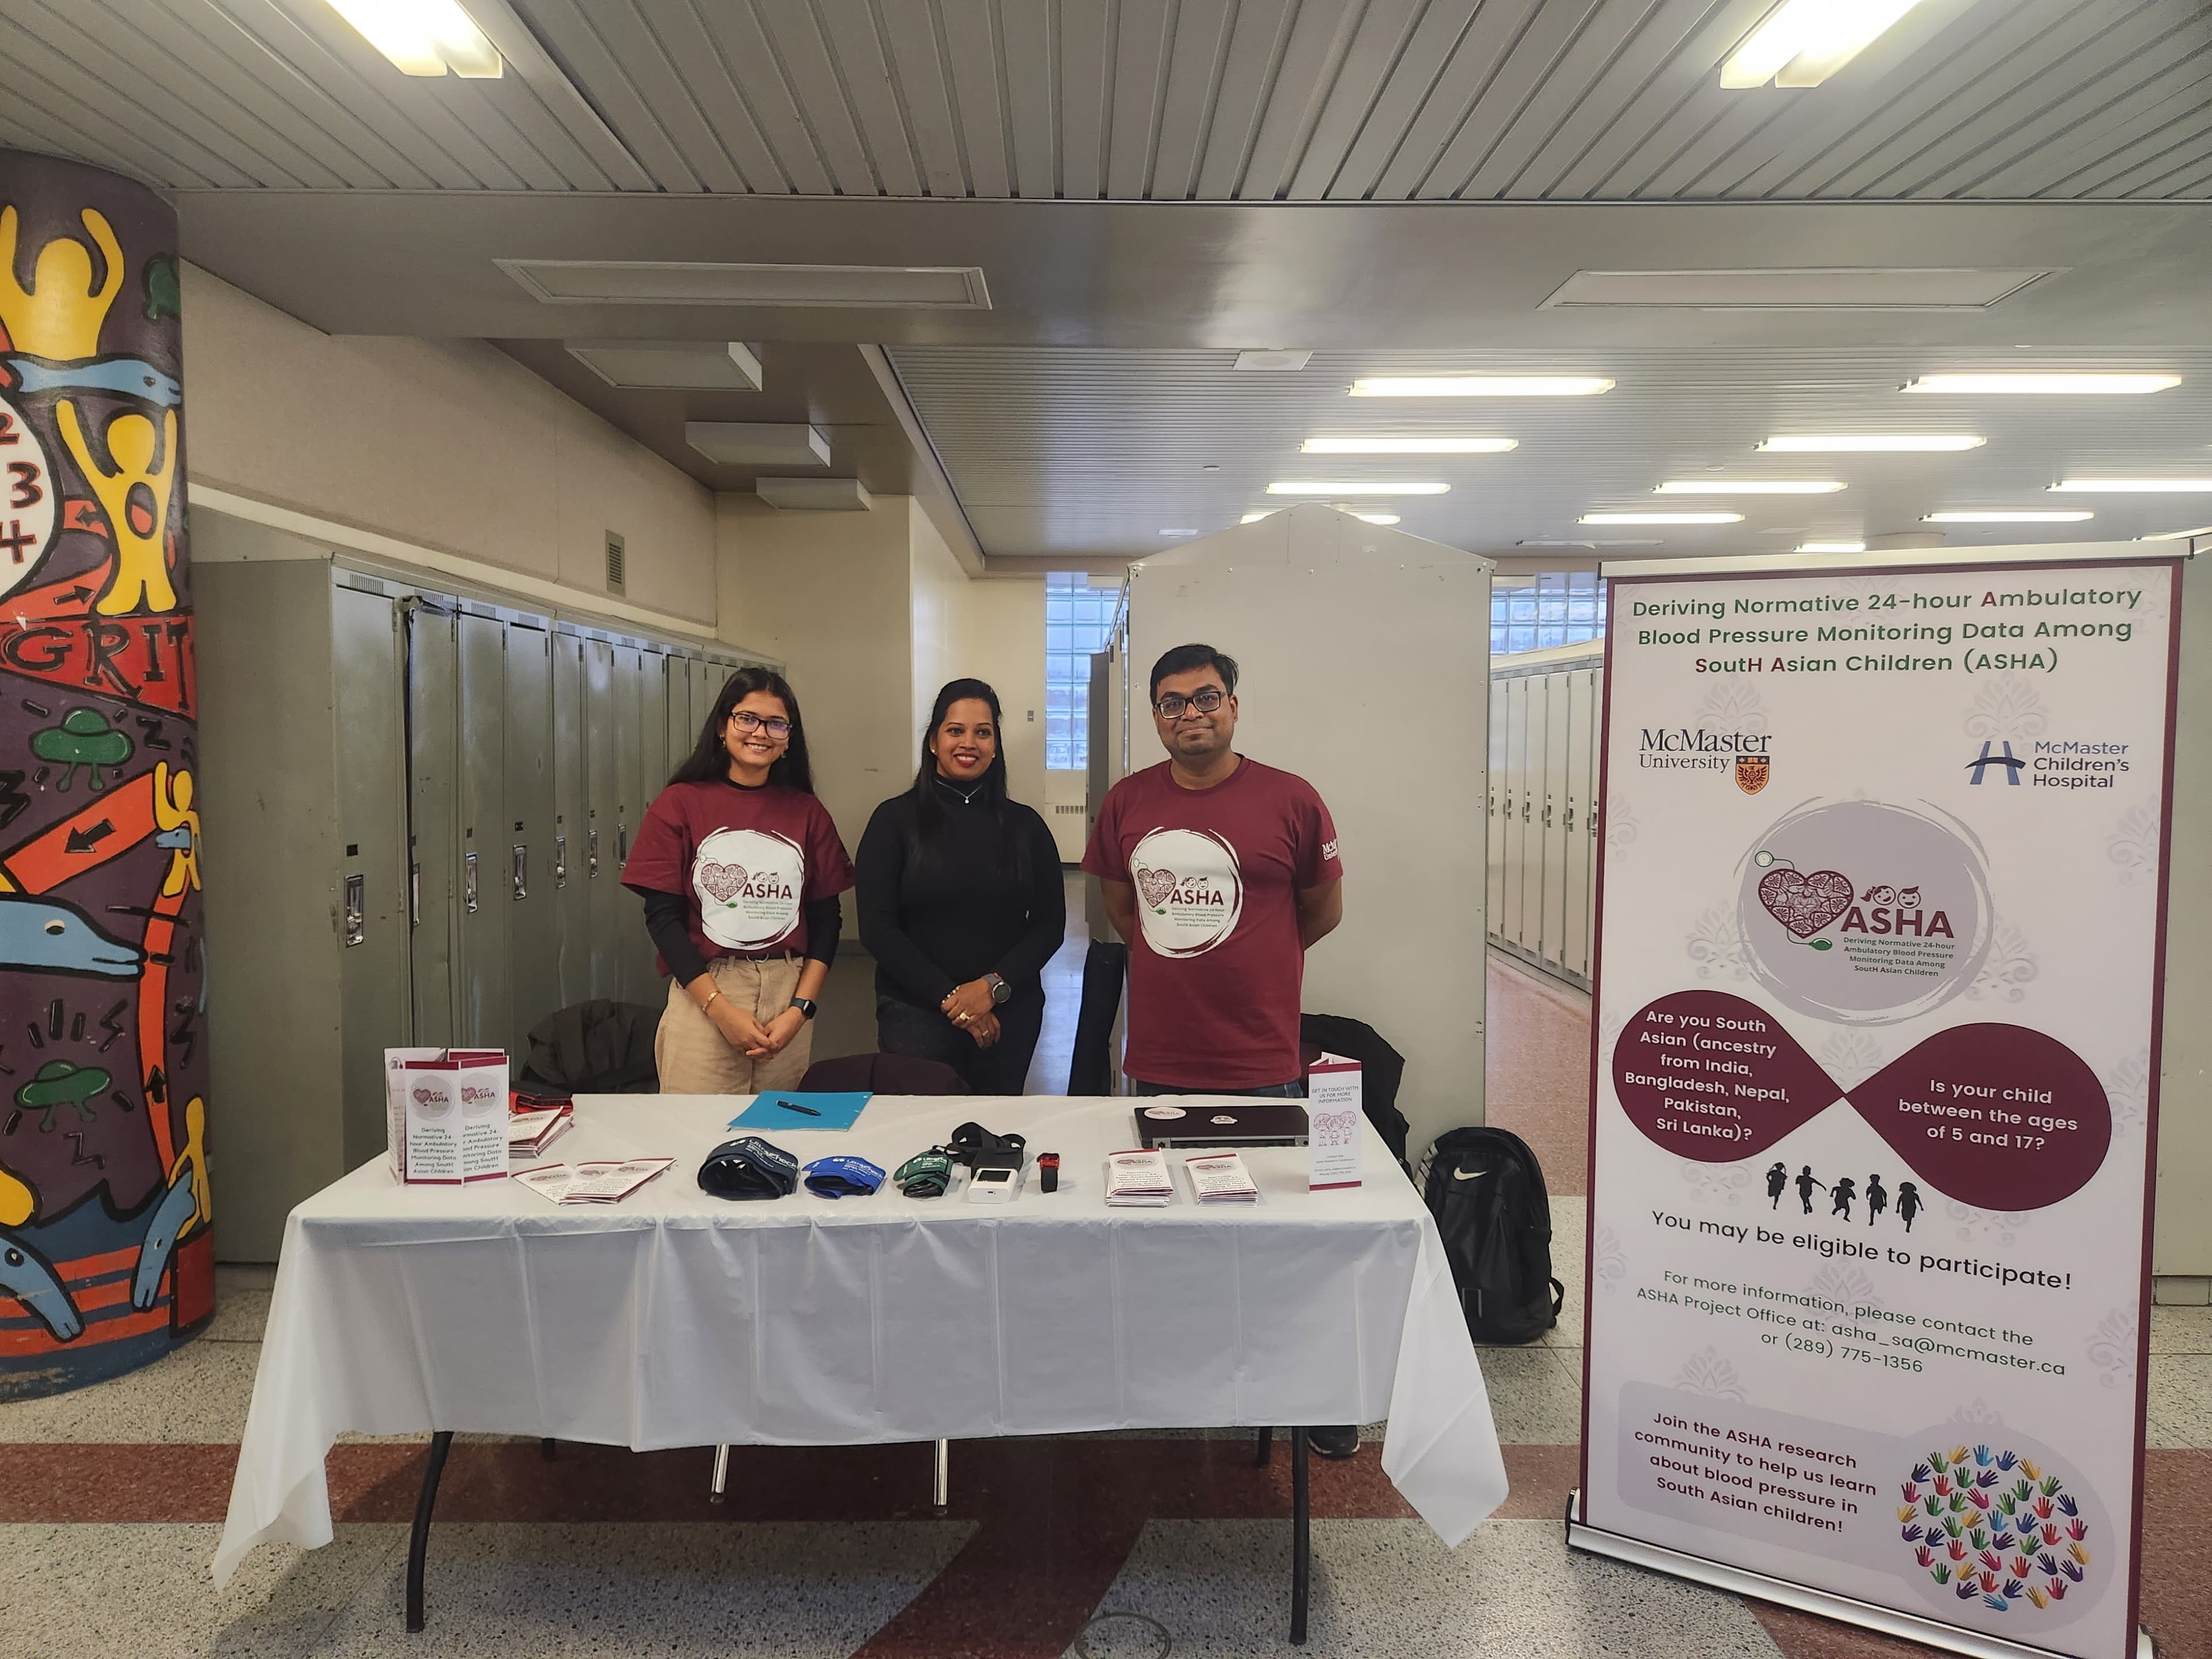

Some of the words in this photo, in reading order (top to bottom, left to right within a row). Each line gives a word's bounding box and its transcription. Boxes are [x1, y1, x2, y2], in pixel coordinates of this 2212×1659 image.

[6, 461, 43, 509] 3
[1633, 599, 1725, 620] Deriving
[1734, 594, 1859, 613] Normative
[1868, 593, 1972, 610] 24-hour
[1980, 588, 2142, 609] Ambulatory
[1638, 628, 1700, 645] Blood
[1709, 629, 1808, 643] Pressure
[1817, 623, 1952, 645] Monitoring
[1962, 622, 2024, 639] Data
[2033, 622, 2132, 642] Among
[0, 618, 194, 710] GRIT
[1695, 657, 1762, 673] SoutH
[1770, 656, 1836, 672] Asian
[1846, 654, 1952, 671] Children
[1964, 647, 2058, 674] (ASHA)
[1639, 729, 1772, 753] McMaster
[2035, 741, 2129, 755] McMaster
[1639, 753, 1730, 774] University
[2033, 757, 2130, 771] Children's
[2033, 774, 2113, 790] Hospital
[742, 883, 792, 899] ASHA
[1170, 889, 1224, 905] ASHA
[1840, 906, 1955, 939] ASHA
[1844, 937, 1876, 945] Deriving
[1844, 946, 1891, 956] Ambulatory
[1849, 956, 1893, 965] Monitoring
[1916, 960, 1945, 968] Among
[1646, 1010, 1674, 1024] Are
[1679, 1016, 1710, 1028] you
[1716, 1017, 1766, 1032] South
[1640, 1031, 1686, 1047] Asian
[1693, 1032, 1777, 1059] (ancestry
[1660, 1054, 1700, 1070] from
[1706, 1059, 1753, 1077] India,
[1625, 1071, 1729, 1097] Bangladesh,
[1734, 1084, 1789, 1103] Nepal,
[1930, 1080, 1945, 1093] Is
[1952, 1084, 1997, 1098] your
[2002, 1088, 2052, 1104] child
[1664, 1097, 1741, 1120] Pakistan,
[1899, 1099, 1982, 1120] between
[1988, 1109, 2021, 1124] the
[2028, 1116, 2078, 1132] ages
[1657, 1118, 1677, 1131] Sri
[1683, 1121, 1752, 1142] Lanka)?
[1927, 1126, 1945, 1139] of
[1952, 1127, 1963, 1141] 5
[1969, 1132, 2008, 1147] and
[2015, 1135, 2045, 1150] 17?
[1652, 1210, 1691, 1230] You
[1699, 1221, 1748, 1244] may
[1757, 1226, 1785, 1244] be
[1793, 1234, 1878, 1260] eligible
[1887, 1248, 1911, 1265] to
[1920, 1255, 2070, 1290] participate!
[1664, 1270, 1688, 1285] For
[1694, 1278, 1737, 1294] more
[1743, 1283, 1849, 1316] information,
[1855, 1305, 1916, 1325] please
[1922, 1318, 1996, 1340] contact
[2002, 1330, 2033, 1346] the
[1637, 1287, 1679, 1305] ASHA
[1684, 1296, 1741, 1317] Project
[1747, 1308, 1796, 1326] Office
[1802, 1320, 1825, 1332] at:
[1832, 1322, 2065, 1376] asha_sa@mcmaster.ca
[1761, 1334, 1778, 1345] or
[1785, 1332, 1833, 1358] (289)
[1840, 1346, 1923, 1373] 775-1356
[1653, 1412, 1687, 1430] Join
[1693, 1421, 1721, 1437] the
[1726, 1429, 1772, 1449] ASHA
[1778, 1442, 1856, 1469] research
[1635, 1431, 1731, 1468] community
[1736, 1453, 1753, 1467] to
[1759, 1457, 1797, 1480] help
[1804, 1470, 1823, 1483] us
[1830, 1474, 1876, 1496] learn
[1650, 1456, 1699, 1476] about
[1705, 1467, 1752, 1488] blood
[1759, 1482, 1836, 1509] pressure
[1842, 1498, 1858, 1514] in
[1657, 1477, 1704, 1499] South
[1710, 1491, 1758, 1512] Asian
[1763, 1498, 1842, 1533] children!
